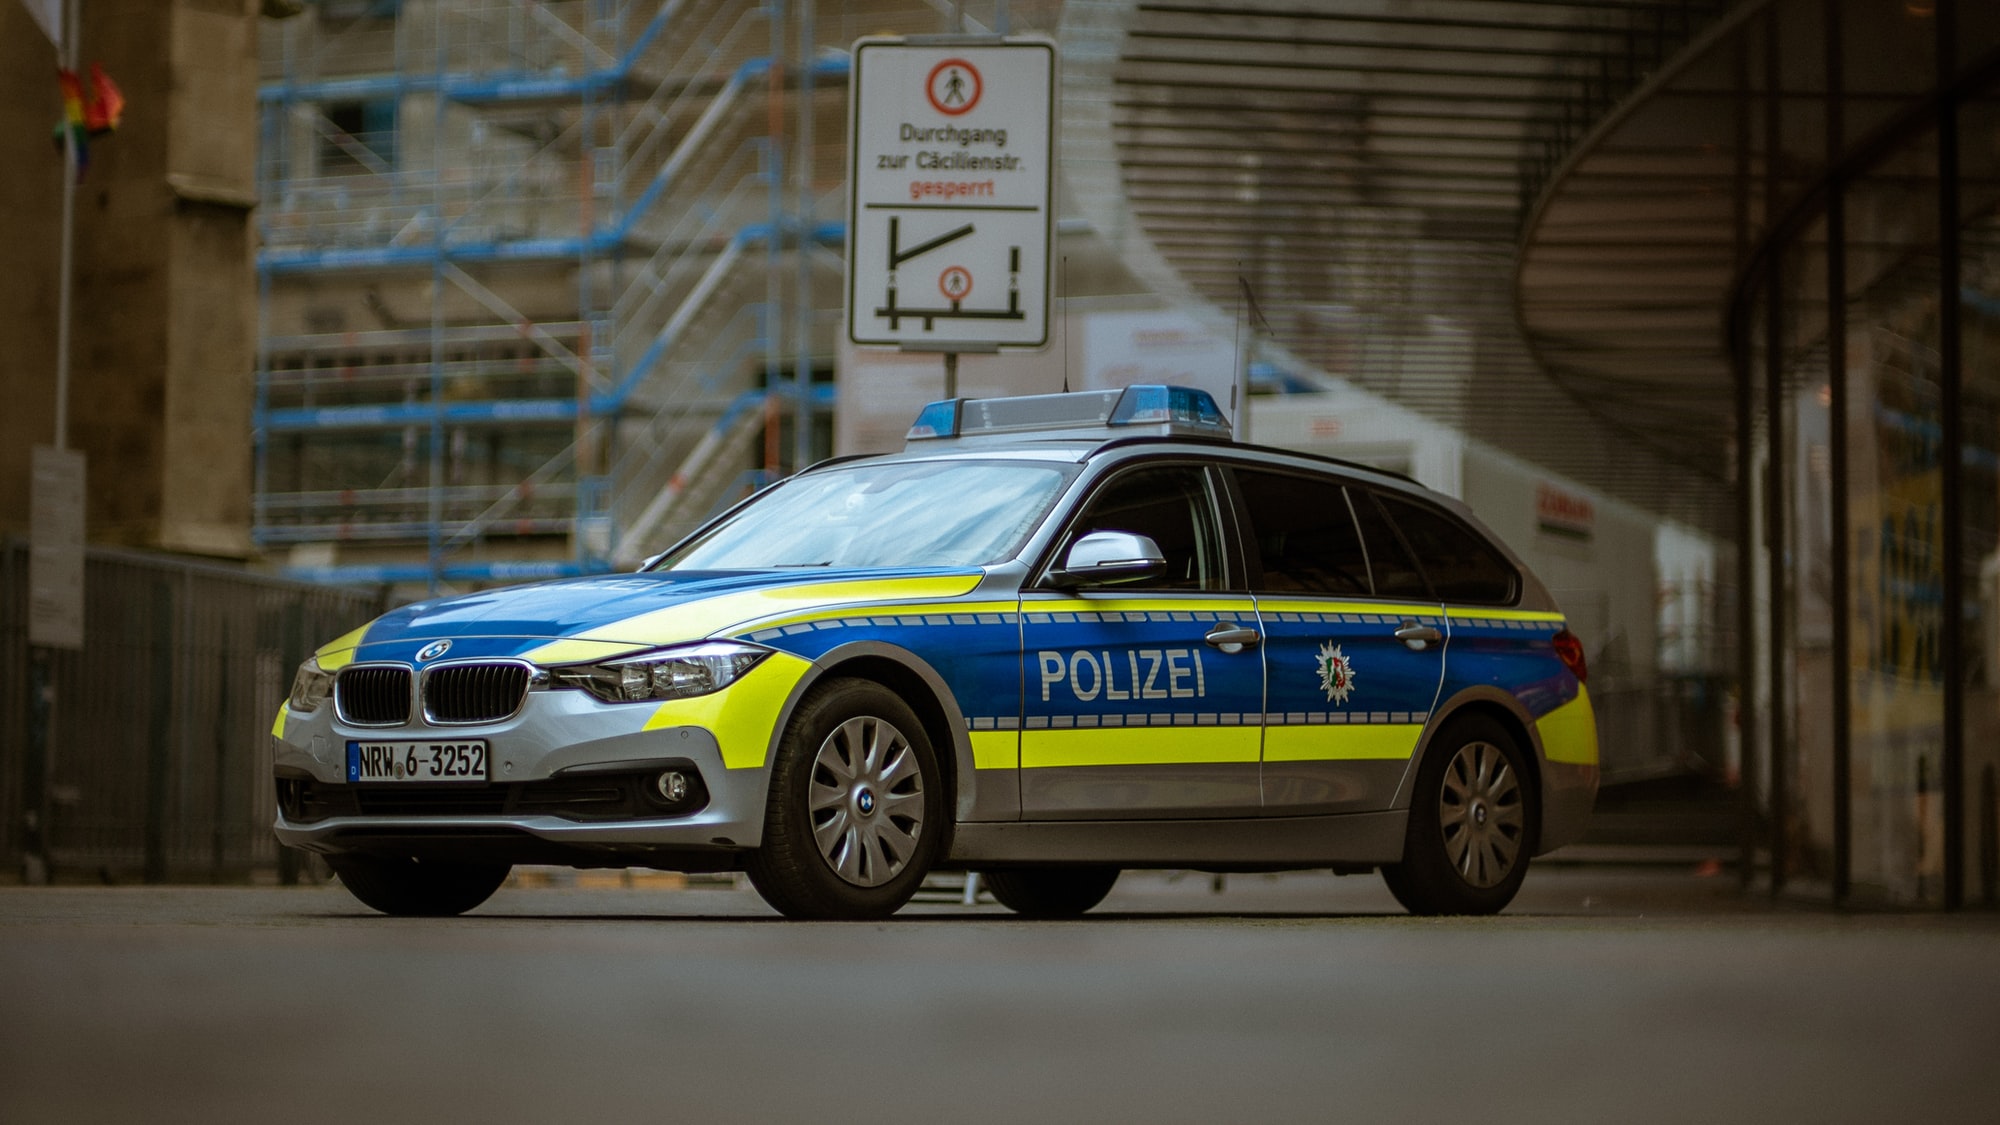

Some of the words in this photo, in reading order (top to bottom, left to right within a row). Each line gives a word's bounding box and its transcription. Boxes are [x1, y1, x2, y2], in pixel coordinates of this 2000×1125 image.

[900, 122, 1007, 147] Durchgang
[877, 154, 909, 170] zur
[916, 151, 1025, 171] Cäcilienstr.
[910, 179, 995, 199] gesperrt
[1038, 648, 1206, 701] POLIZEI
[359, 745, 394, 777] NRW
[405, 744, 485, 777] 6-3252
